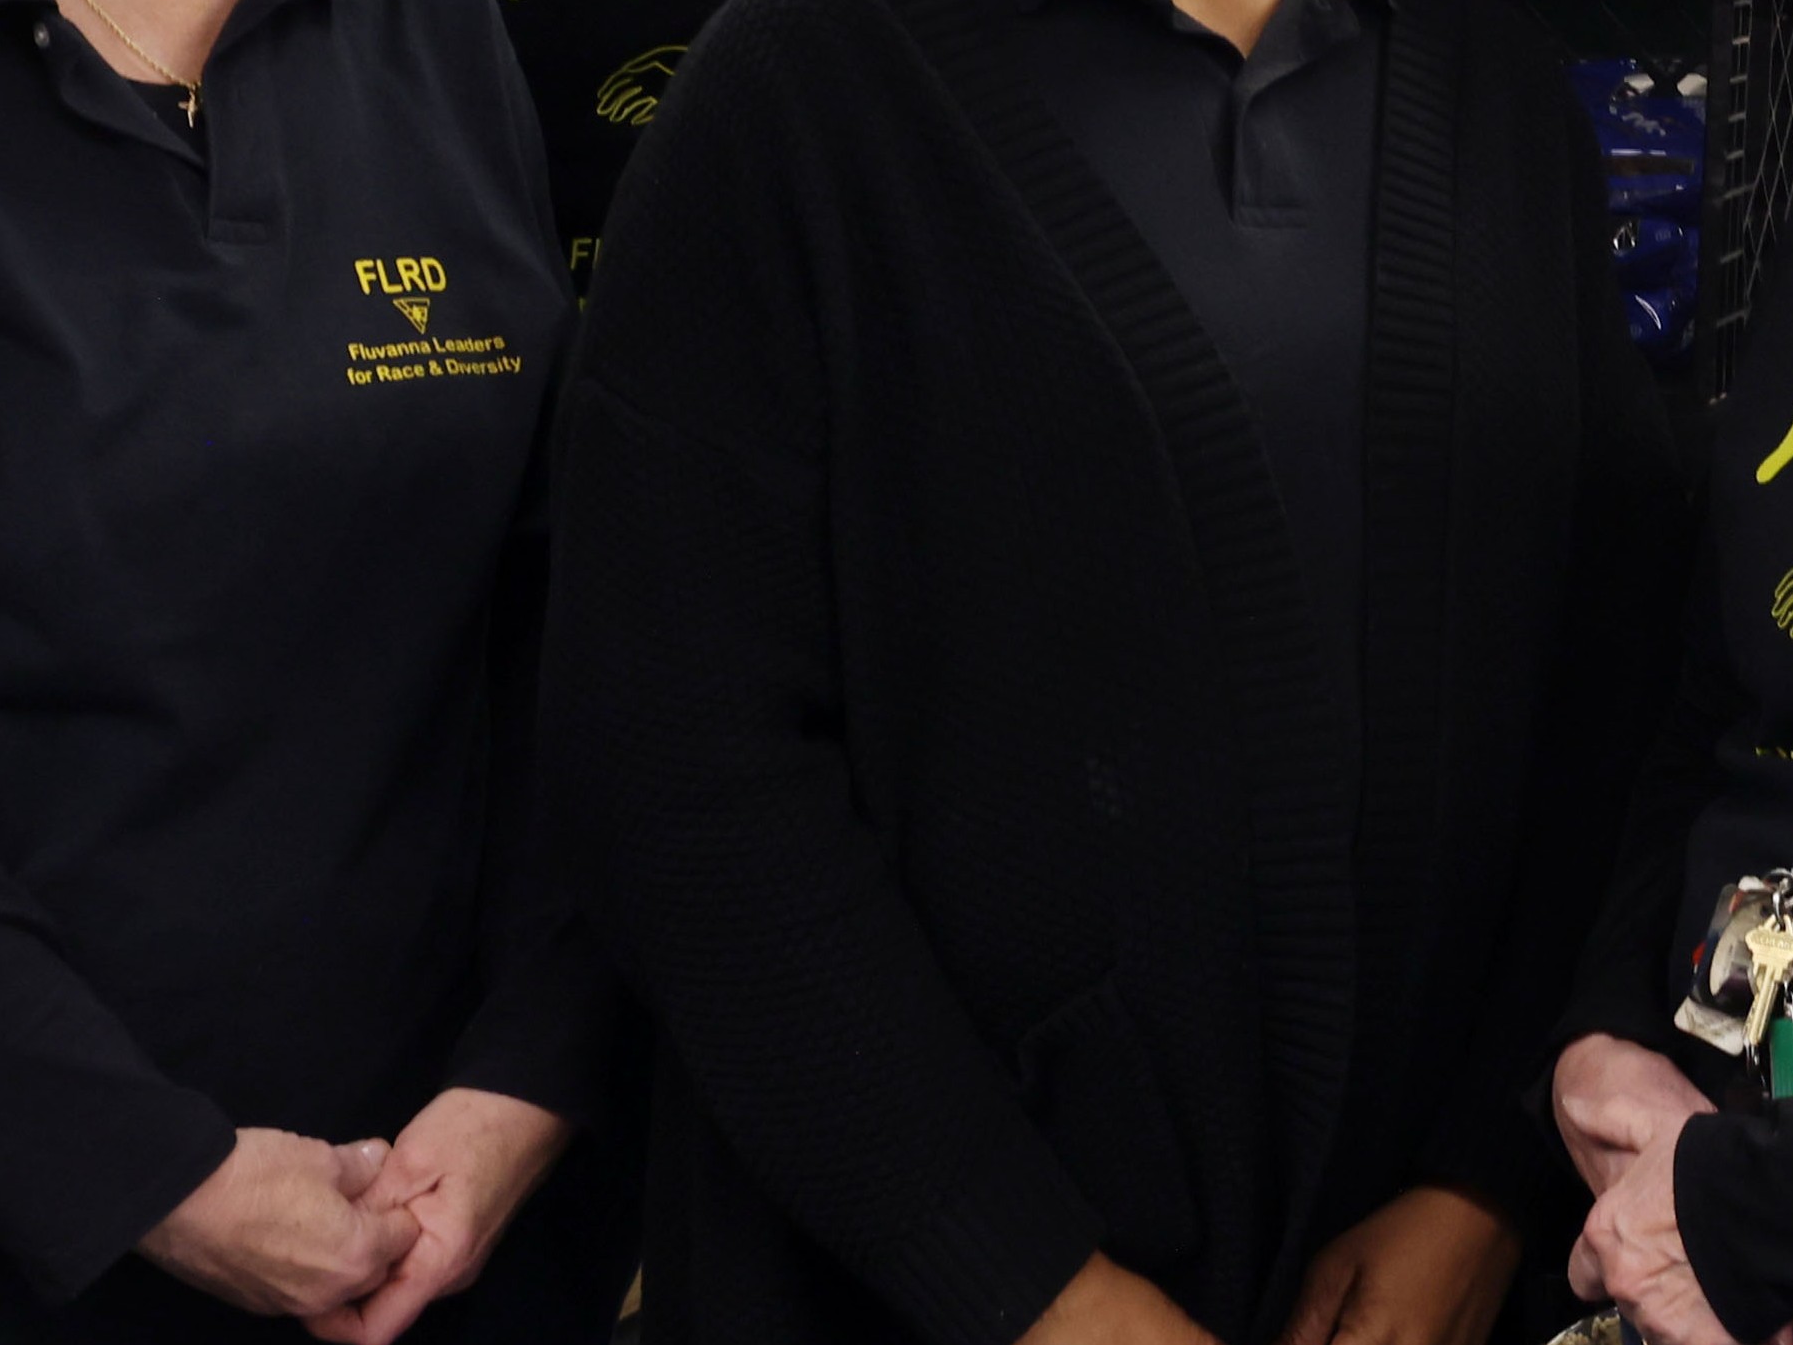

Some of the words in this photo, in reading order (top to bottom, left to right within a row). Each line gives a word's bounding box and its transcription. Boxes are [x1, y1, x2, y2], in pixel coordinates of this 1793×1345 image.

[354, 257, 447, 295] FLRD
[347, 340, 432, 361] Fluvanna
[432, 335, 505, 354] Leaders
[347, 368, 372, 386] for
[376, 364, 425, 383] Race
[428, 359, 444, 376] &
[445, 356, 522, 376] Diversity
